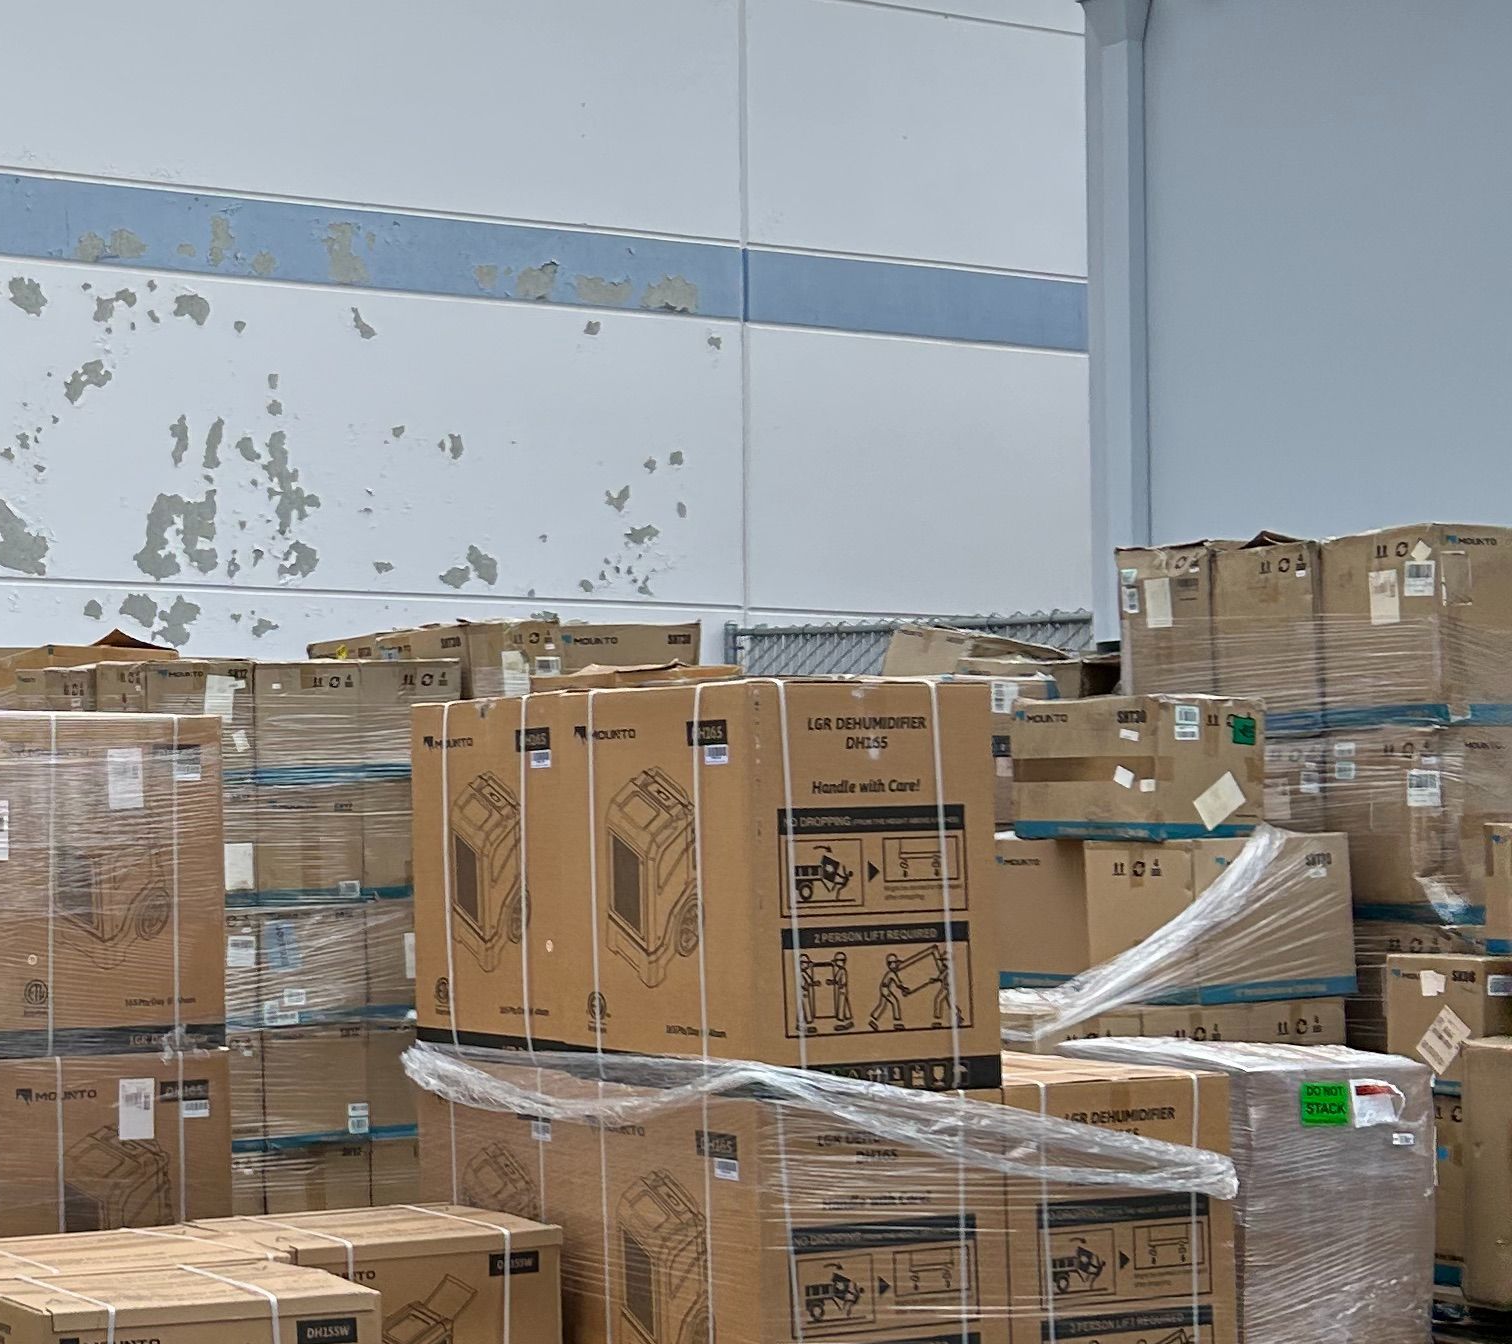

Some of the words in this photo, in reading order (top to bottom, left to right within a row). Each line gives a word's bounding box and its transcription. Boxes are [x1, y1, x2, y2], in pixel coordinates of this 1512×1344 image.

[807, 717, 832, 731] LGR
[835, 716, 927, 731] DEHUMIDIFIER
[845, 736, 888, 750] DH165
[811, 779, 855, 794] Handle
[859, 777, 886, 794] with
[888, 777, 921, 793] Care!
[799, 814, 852, 828] DROPPING
[813, 933, 821, 944] 2
[822, 930, 863, 944] PERSON
[864, 929, 886, 942] LIFT
[886, 927, 938, 941] REQUIRED
[1306, 1086, 1321, 1096] DO
[1323, 1086, 1344, 1096] NOT
[1090, 1106, 1176, 1124] DEHUMIDIFIER
[1306, 1102, 1348, 1115] STACK
[306, 1324, 351, 1339] DH155W
